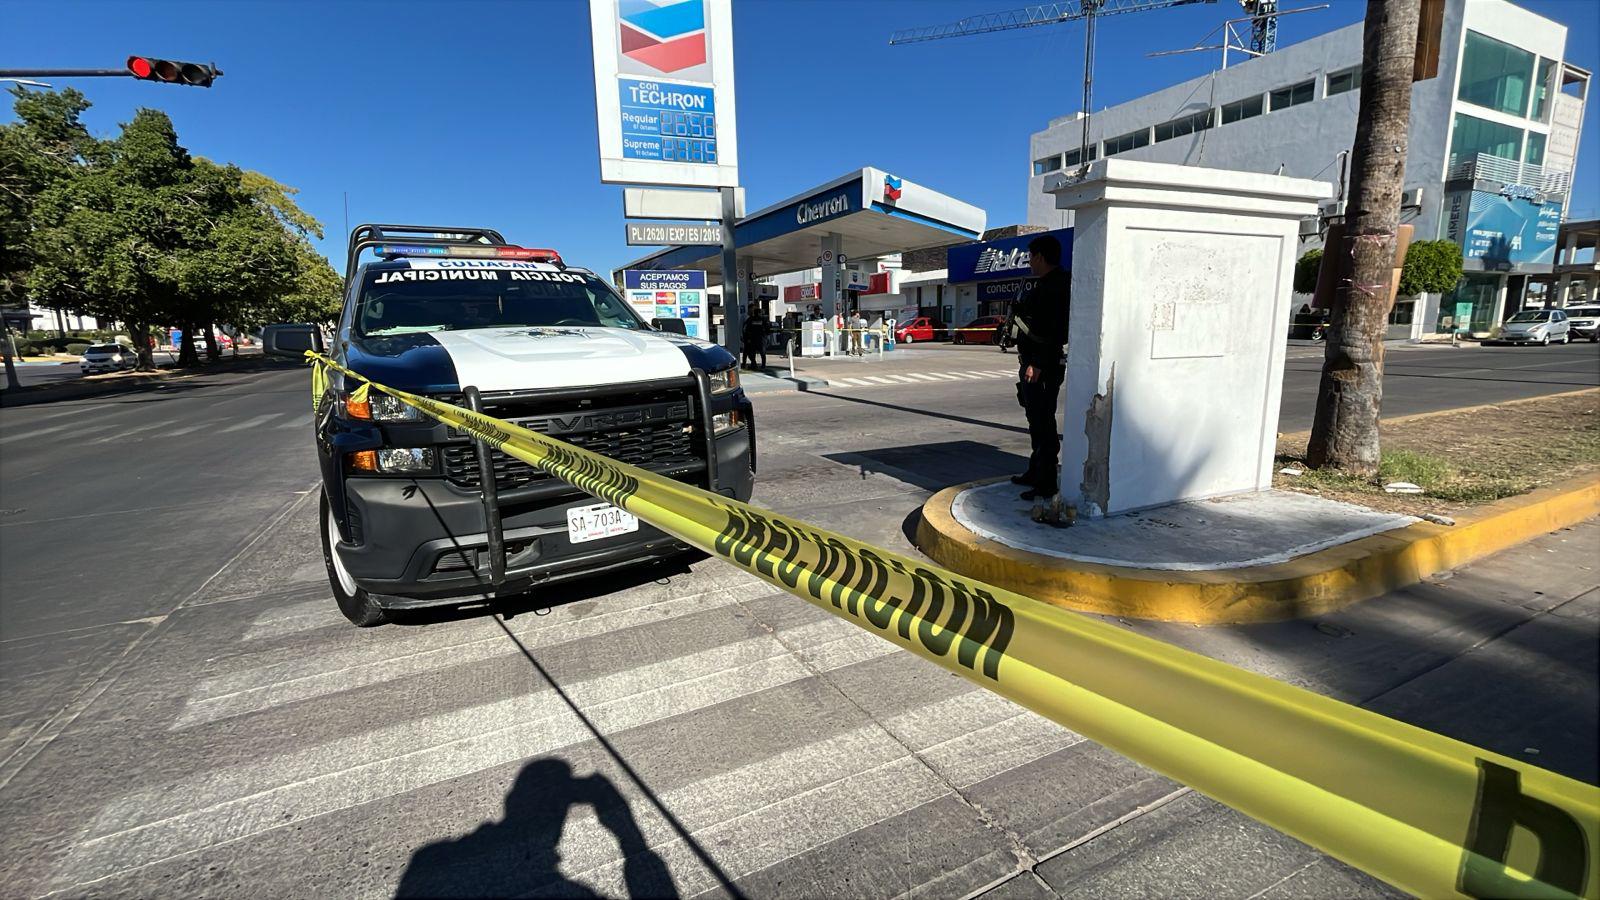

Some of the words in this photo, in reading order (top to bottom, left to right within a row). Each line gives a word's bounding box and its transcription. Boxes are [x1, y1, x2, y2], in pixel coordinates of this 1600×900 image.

[639, 82, 659, 90] con
[628, 86, 706, 110] TECHRON
[622, 112, 658, 125] Regular
[623, 138, 660, 149] Supreme
[796, 193, 848, 224] Chevron
[990, 247, 1031, 272] telce
[640, 273, 690, 281] ACEPTAMOS
